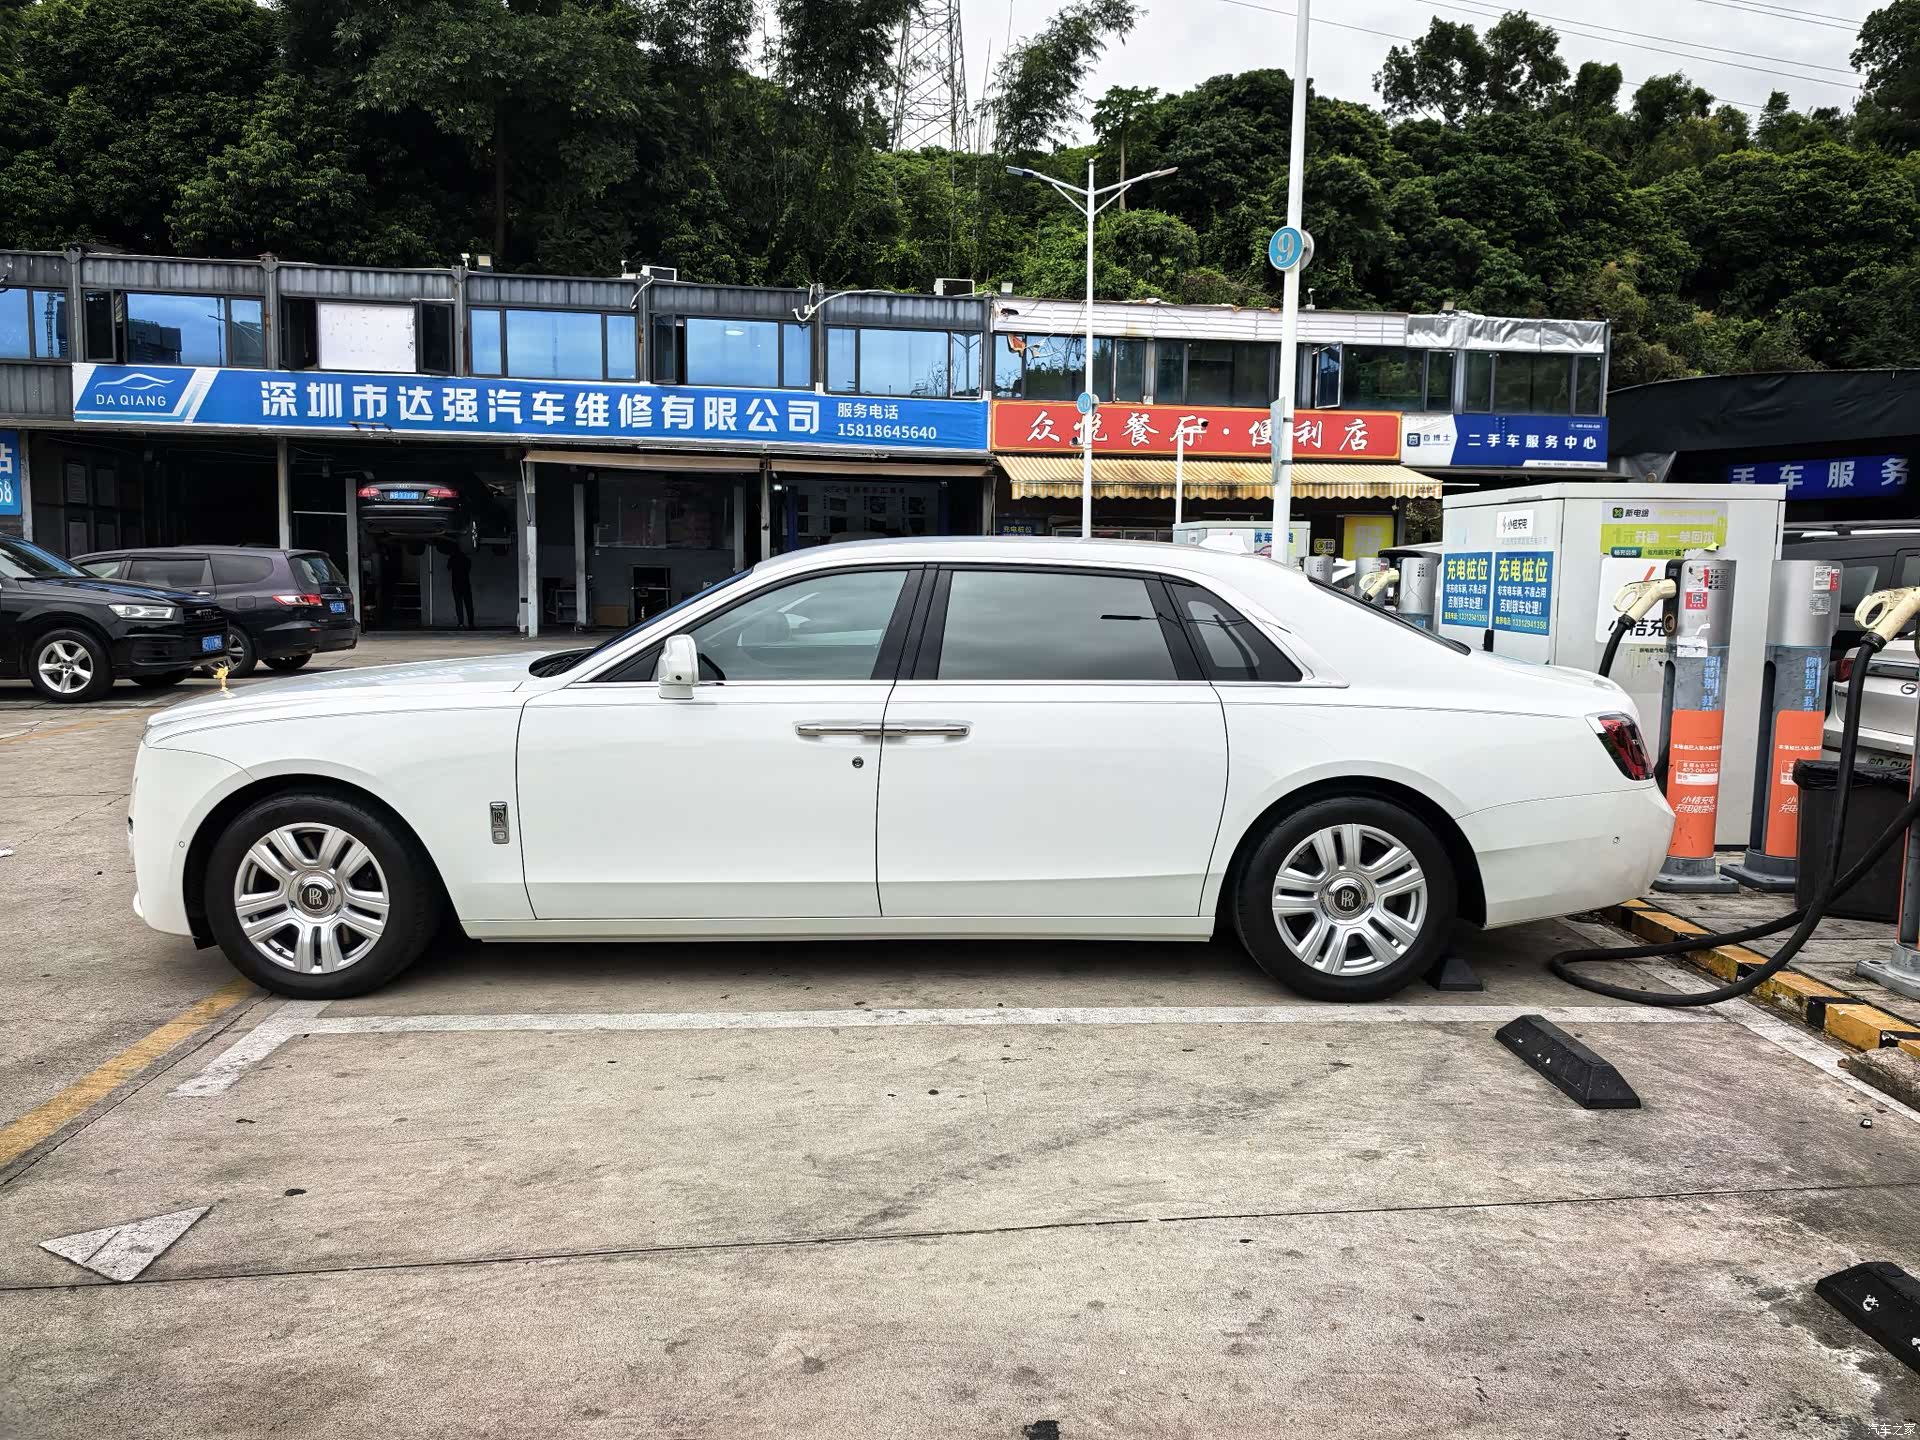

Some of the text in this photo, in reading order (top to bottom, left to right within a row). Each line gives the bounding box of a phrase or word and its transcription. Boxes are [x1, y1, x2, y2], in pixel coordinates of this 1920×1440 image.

[1277, 232, 1295, 264] 9
[96, 394, 167, 407] DA QIANG
[261, 380, 821, 435] 深圳市达强汽车维修有限公司
[837, 401, 899, 420] 服务电话
[837, 422, 938, 440] 15818645640
[1467, 433, 1597, 450] 二手车服务中心
[1447, 558, 1489, 581] 充电桩位
[1498, 557, 1548, 583] 充电桩位
